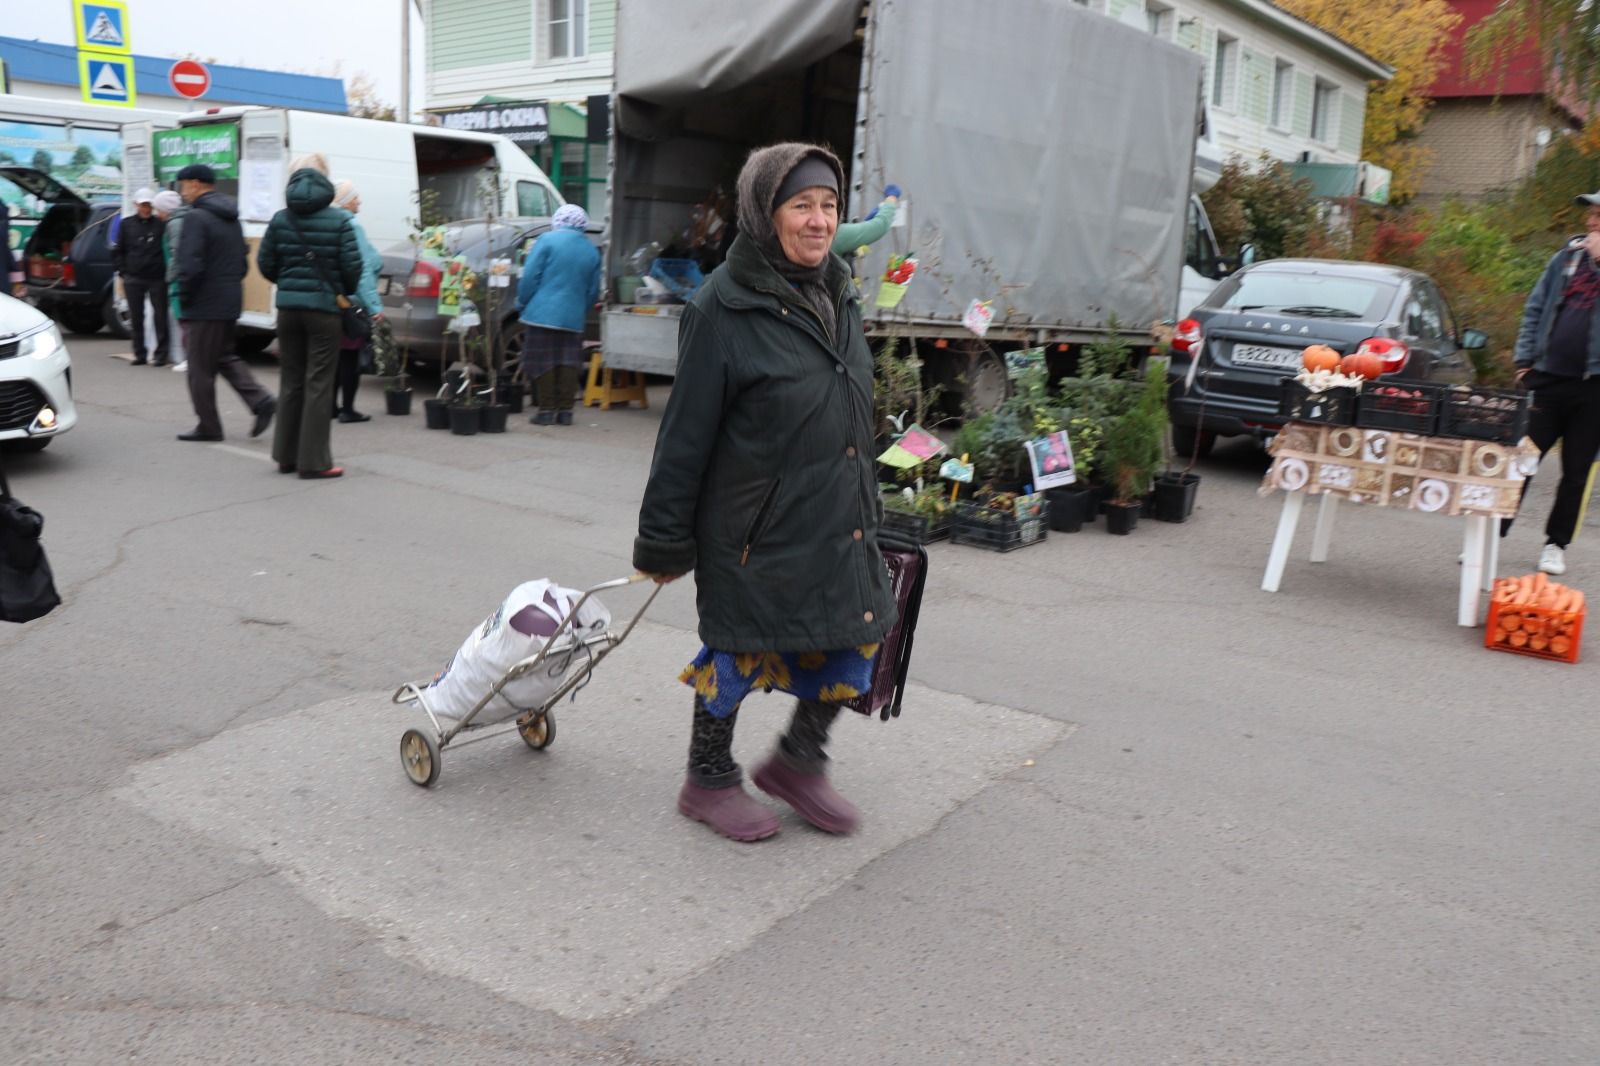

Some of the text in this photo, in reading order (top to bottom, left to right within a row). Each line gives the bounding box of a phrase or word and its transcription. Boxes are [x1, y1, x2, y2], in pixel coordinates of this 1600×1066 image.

[445, 107, 547, 130] ДВЕРИ & ОКНА
[1245, 320, 1309, 334] LADA
